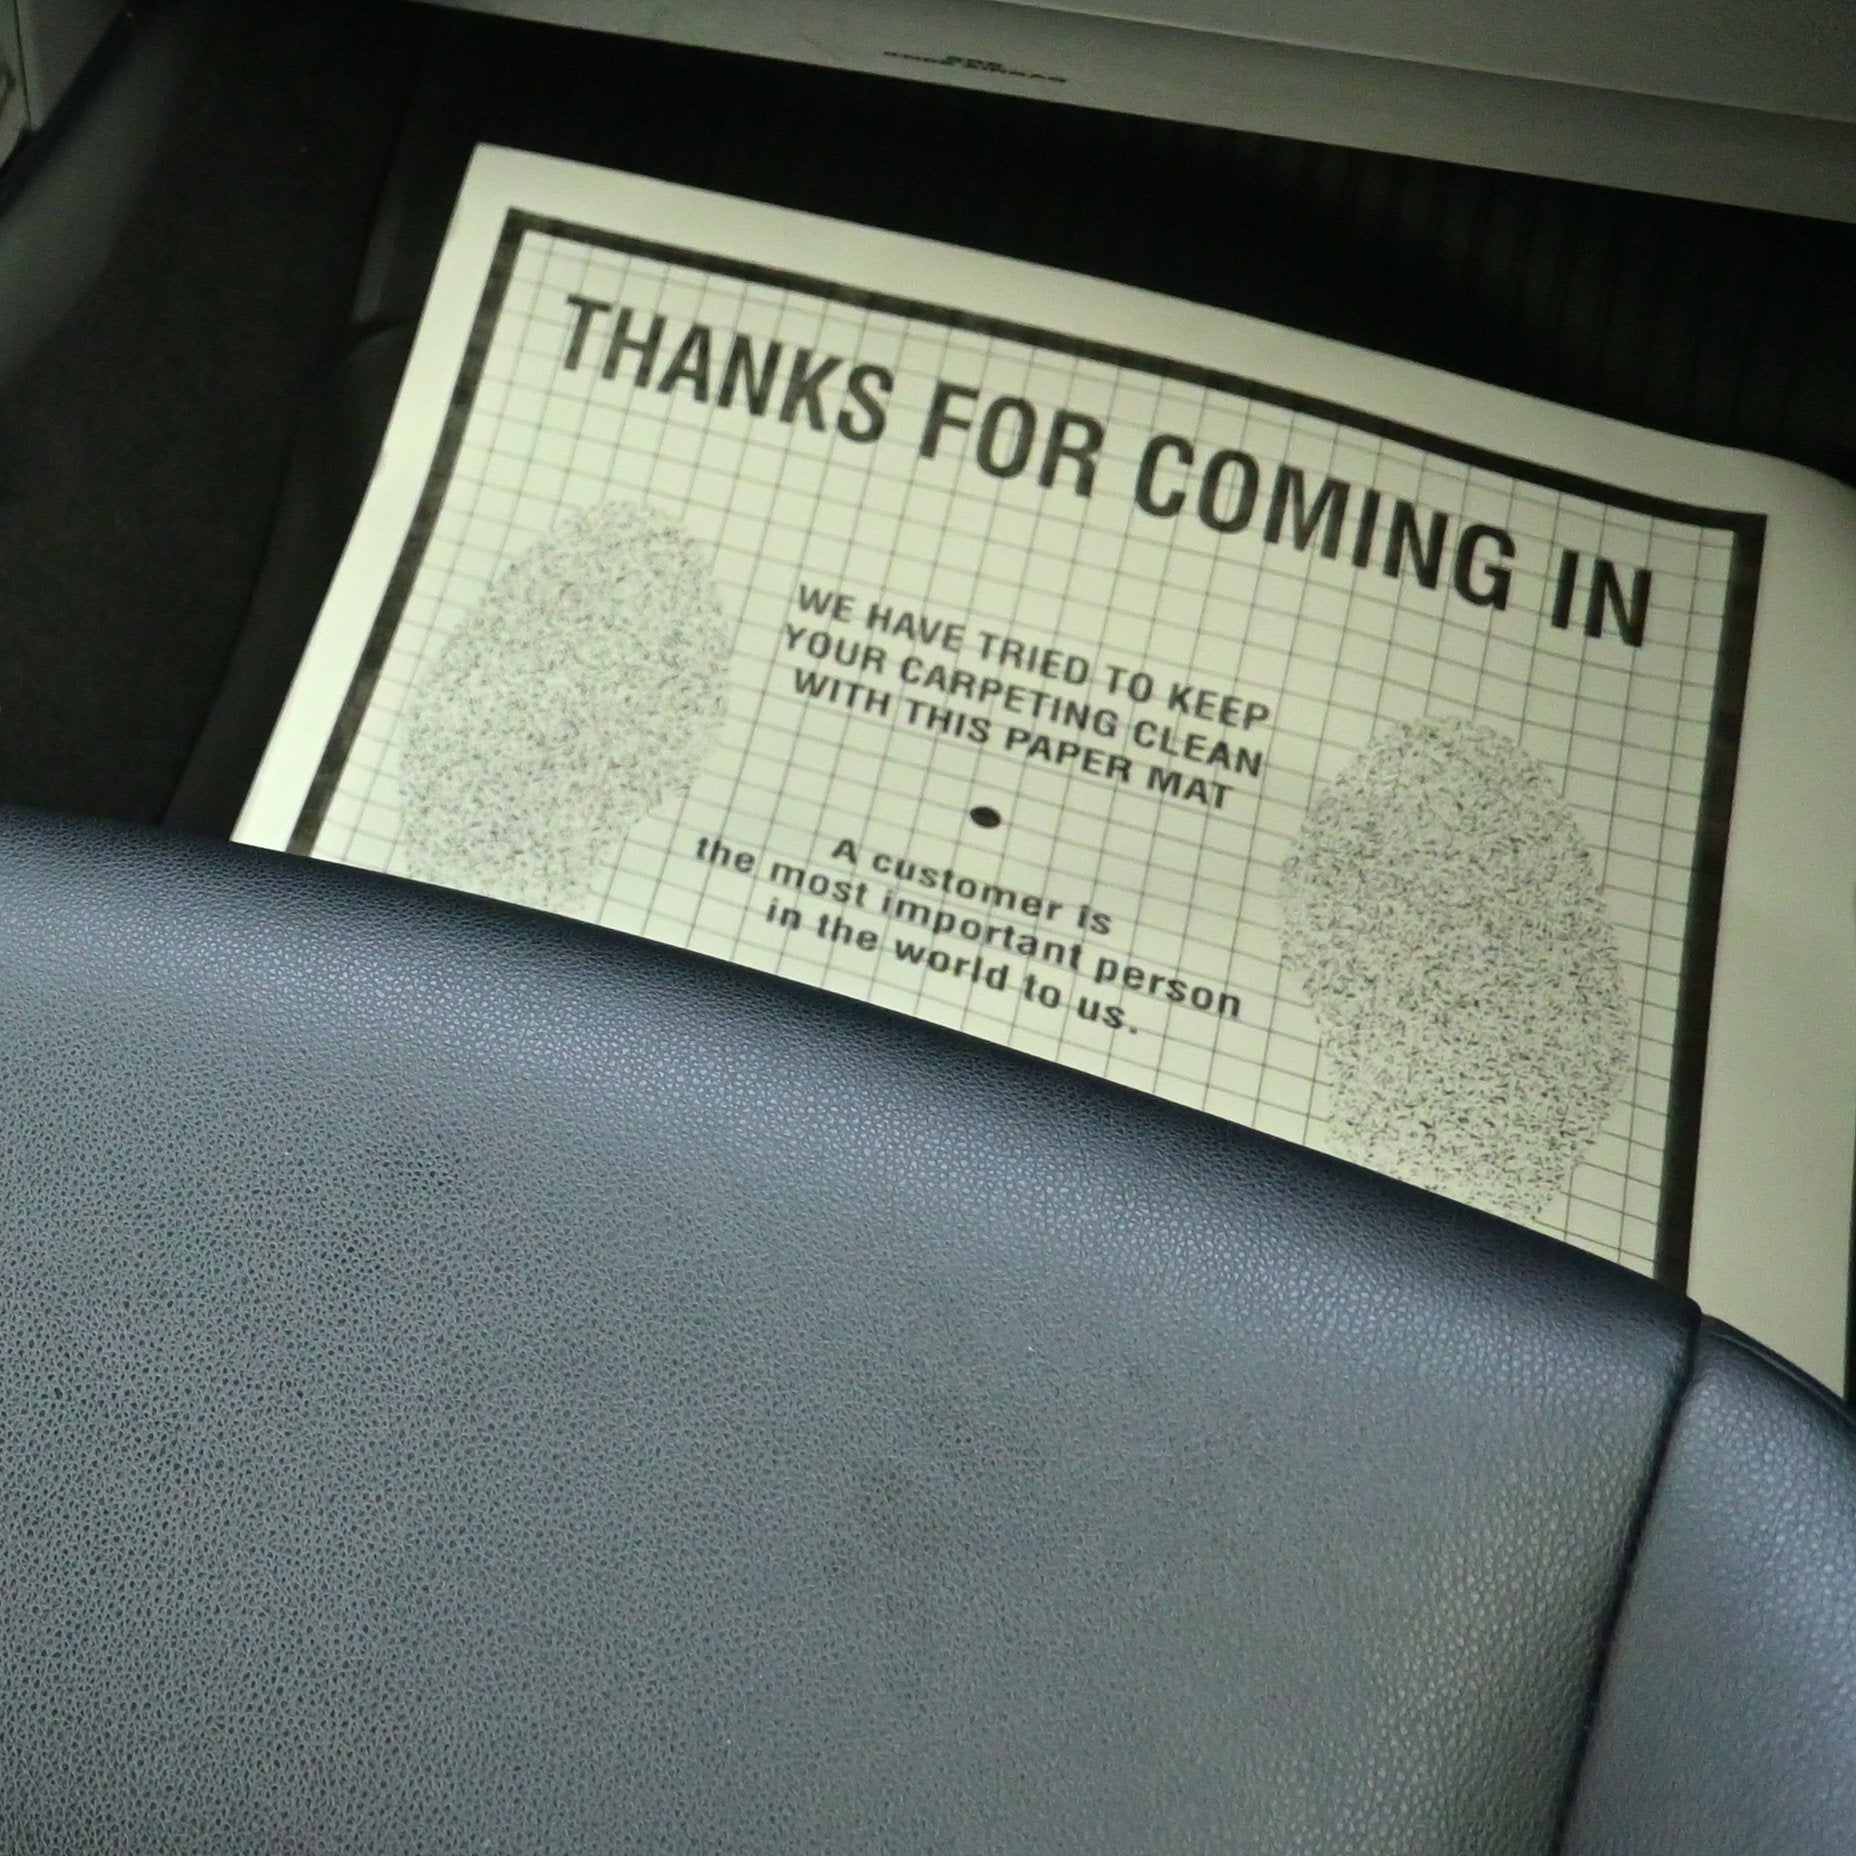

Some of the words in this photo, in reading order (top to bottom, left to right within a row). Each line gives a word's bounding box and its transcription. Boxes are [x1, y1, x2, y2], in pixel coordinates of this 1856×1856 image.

[562, 293, 896, 445] THANKS
[917, 378, 1107, 499] FOR
[1133, 432, 1517, 612] COMING
[1549, 546, 1653, 649] IN
[784, 622, 888, 675] YOUR
[899, 654, 1120, 739] CARPETING
[1132, 719, 1264, 779] CLEAN
[798, 583, 858, 624] WE
[866, 601, 967, 654] HAVE
[979, 630, 1091, 687] TRIED
[1105, 664, 1155, 704] TO
[1167, 682, 1272, 732] KEEP
[793, 667, 891, 718] WITH
[904, 697, 993, 745] THIS
[1003, 726, 1134, 784] PAPER
[1146, 764, 1233, 811] MAT
[695, 835, 756, 875] the
[770, 860, 869, 907] most
[881, 889, 1083, 973] important
[1093, 954, 1243, 1019] person
[830, 838, 859, 866] A
[871, 850, 1065, 923] customer
[1076, 902, 1113, 937] is
[765, 897, 803, 932] in
[816, 913, 879, 953] the
[893, 939, 1009, 993] world
[1022, 970, 1063, 1010] to
[1075, 998, 1141, 1036] us.
